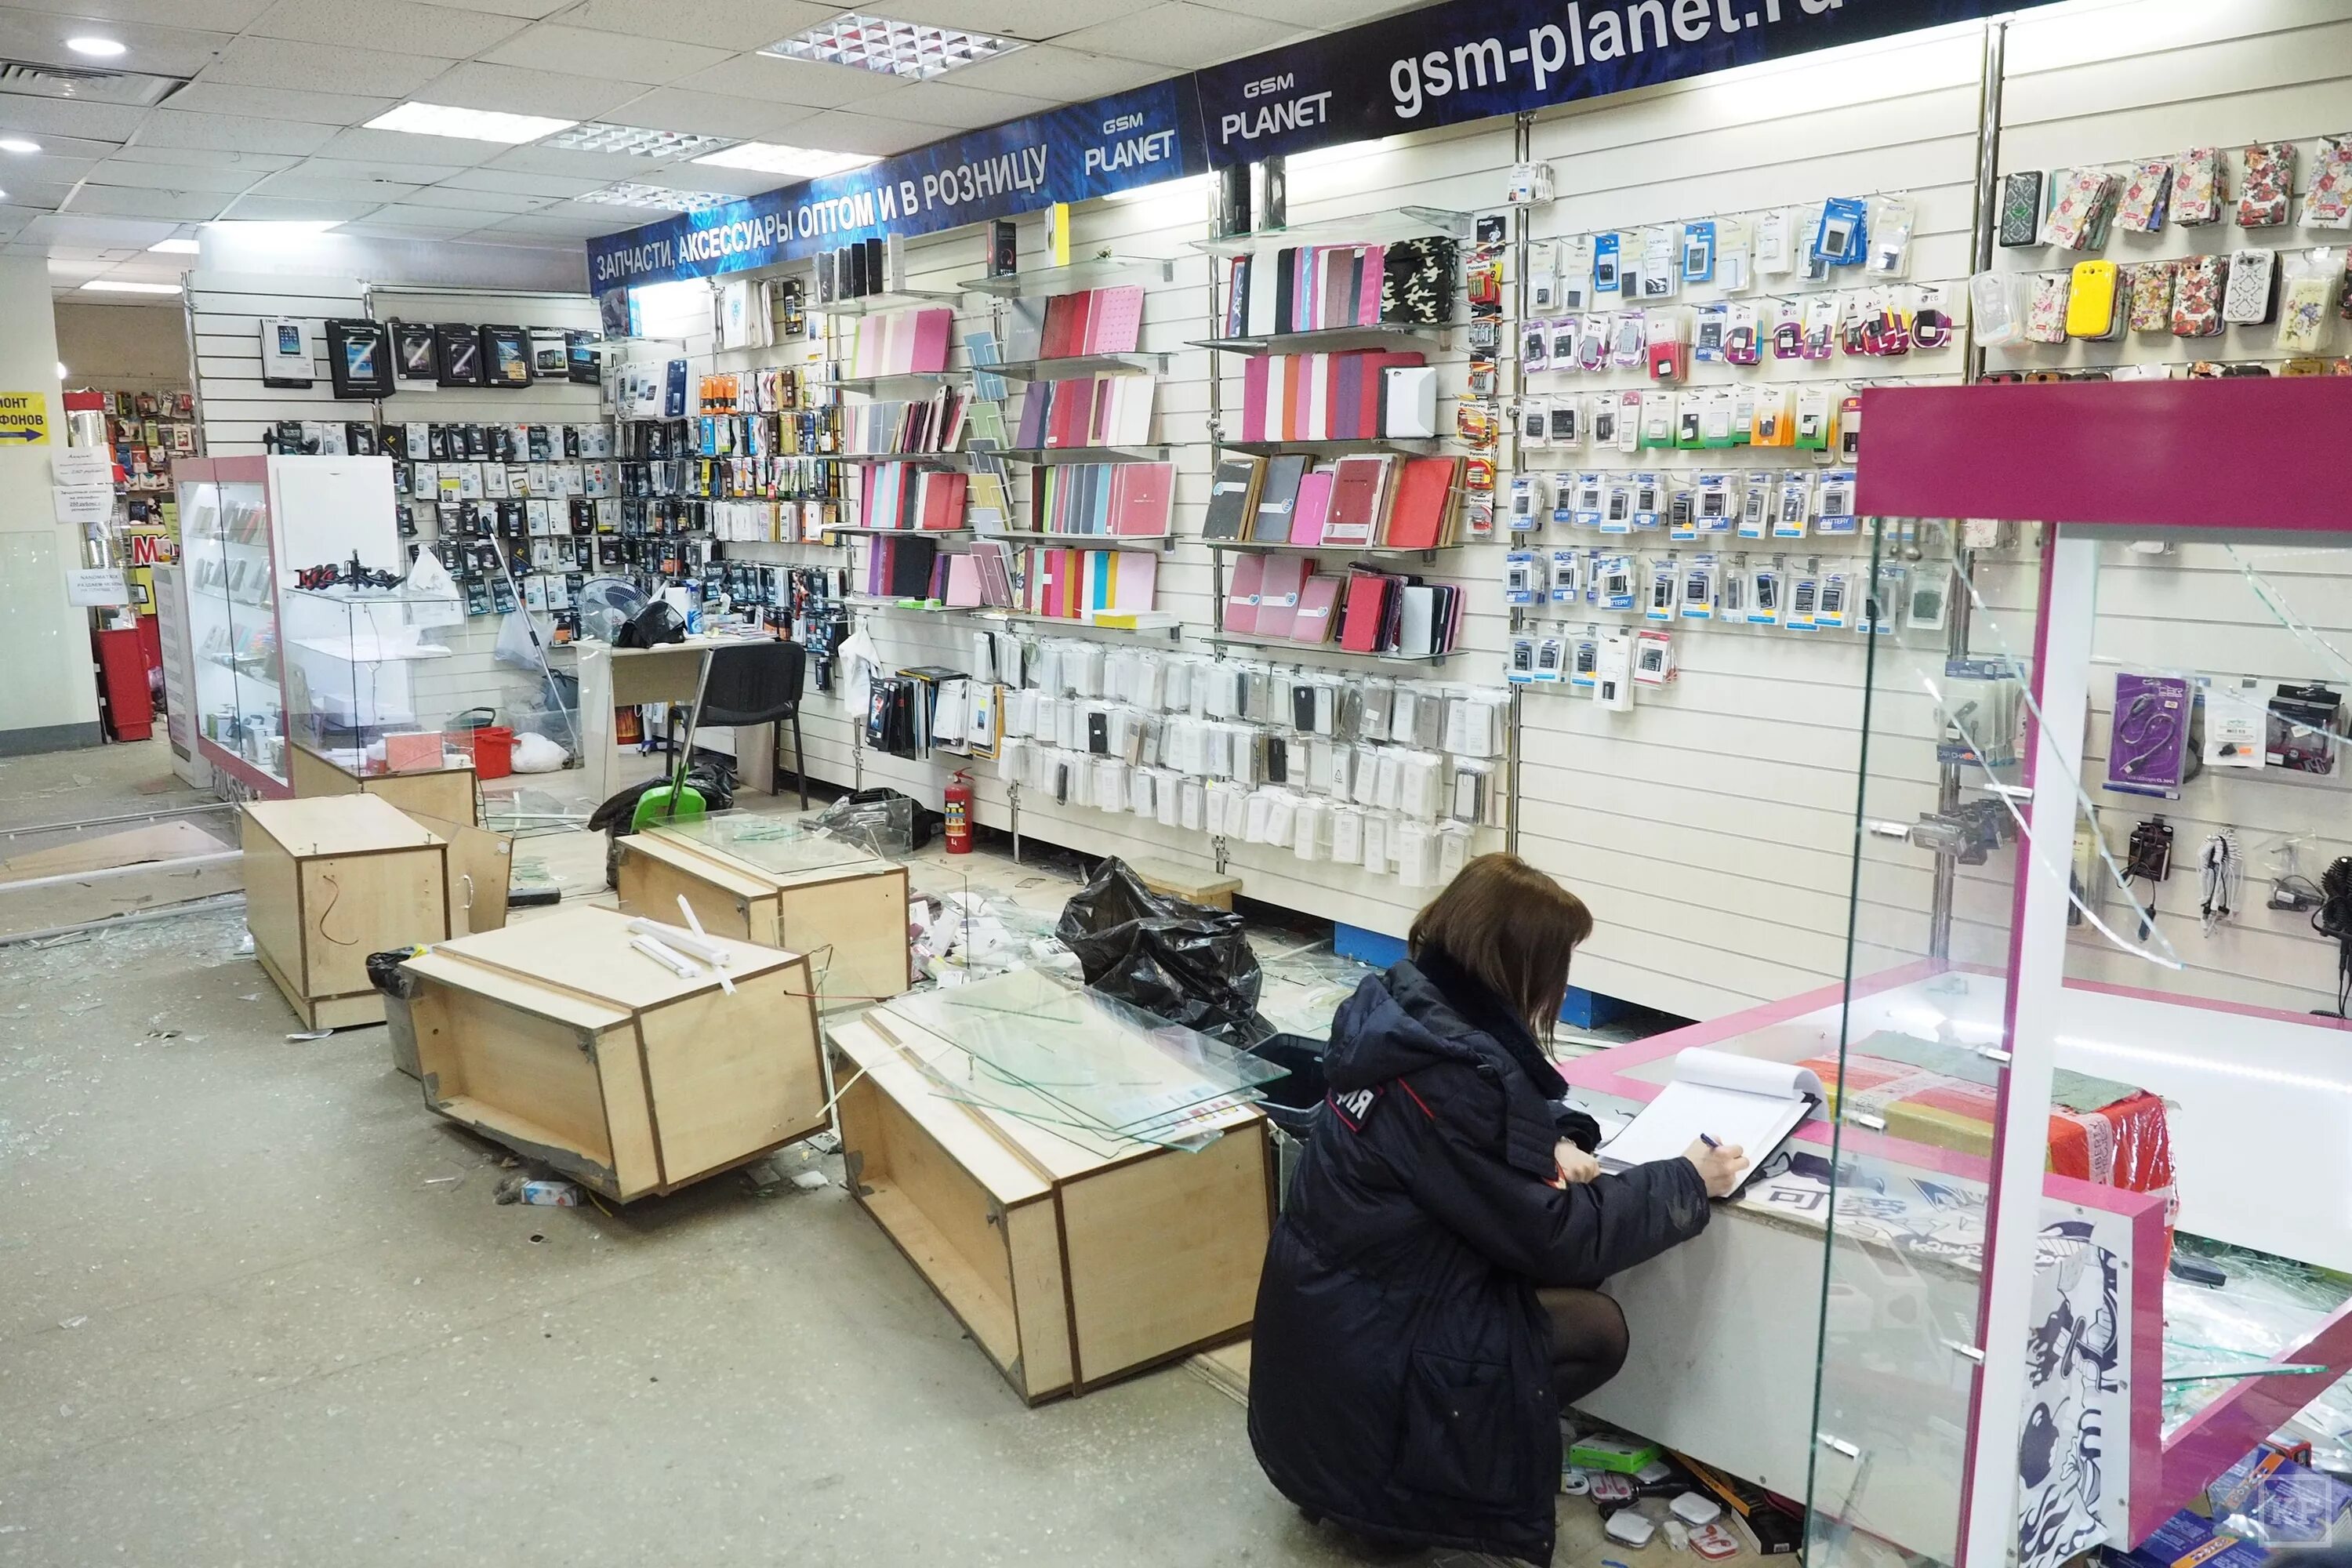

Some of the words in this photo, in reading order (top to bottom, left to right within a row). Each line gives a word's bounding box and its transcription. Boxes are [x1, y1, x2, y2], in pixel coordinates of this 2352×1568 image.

[1243, 73, 1295, 100] GSM
[1102, 111, 1144, 135] GSM
[1221, 91, 1333, 145] PLANET
[1084, 129, 1175, 176] PLANET
[596, 240, 677, 281] ЗАПЧАСТИ,
[678, 210, 793, 264] АКСЕССУАРЫ
[797, 191, 875, 238] ОПТОМ
[877, 185, 897, 223] И
[901, 180, 919, 216] В
[924, 143, 1048, 210] РОЗНИЦУ
